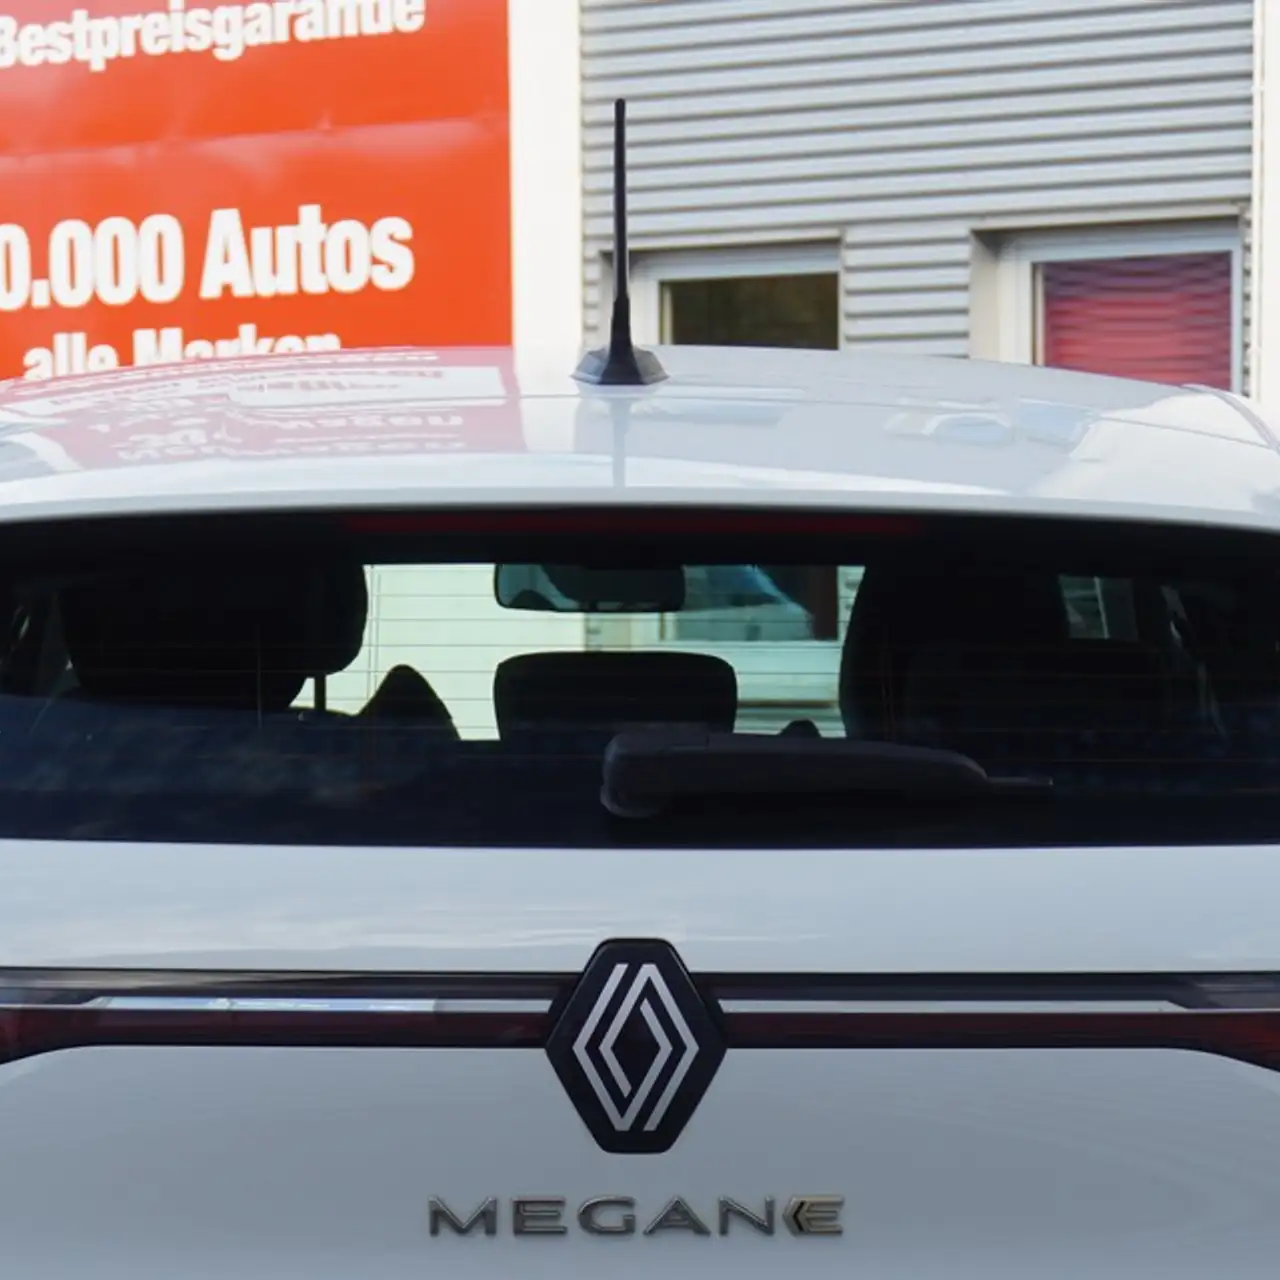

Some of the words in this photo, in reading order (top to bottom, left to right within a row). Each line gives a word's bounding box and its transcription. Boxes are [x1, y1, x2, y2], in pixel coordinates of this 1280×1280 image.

[200, 204, 414, 299] Autos
[22, 331, 118, 381] alle
[428, 1195, 845, 1238] MEGANE
